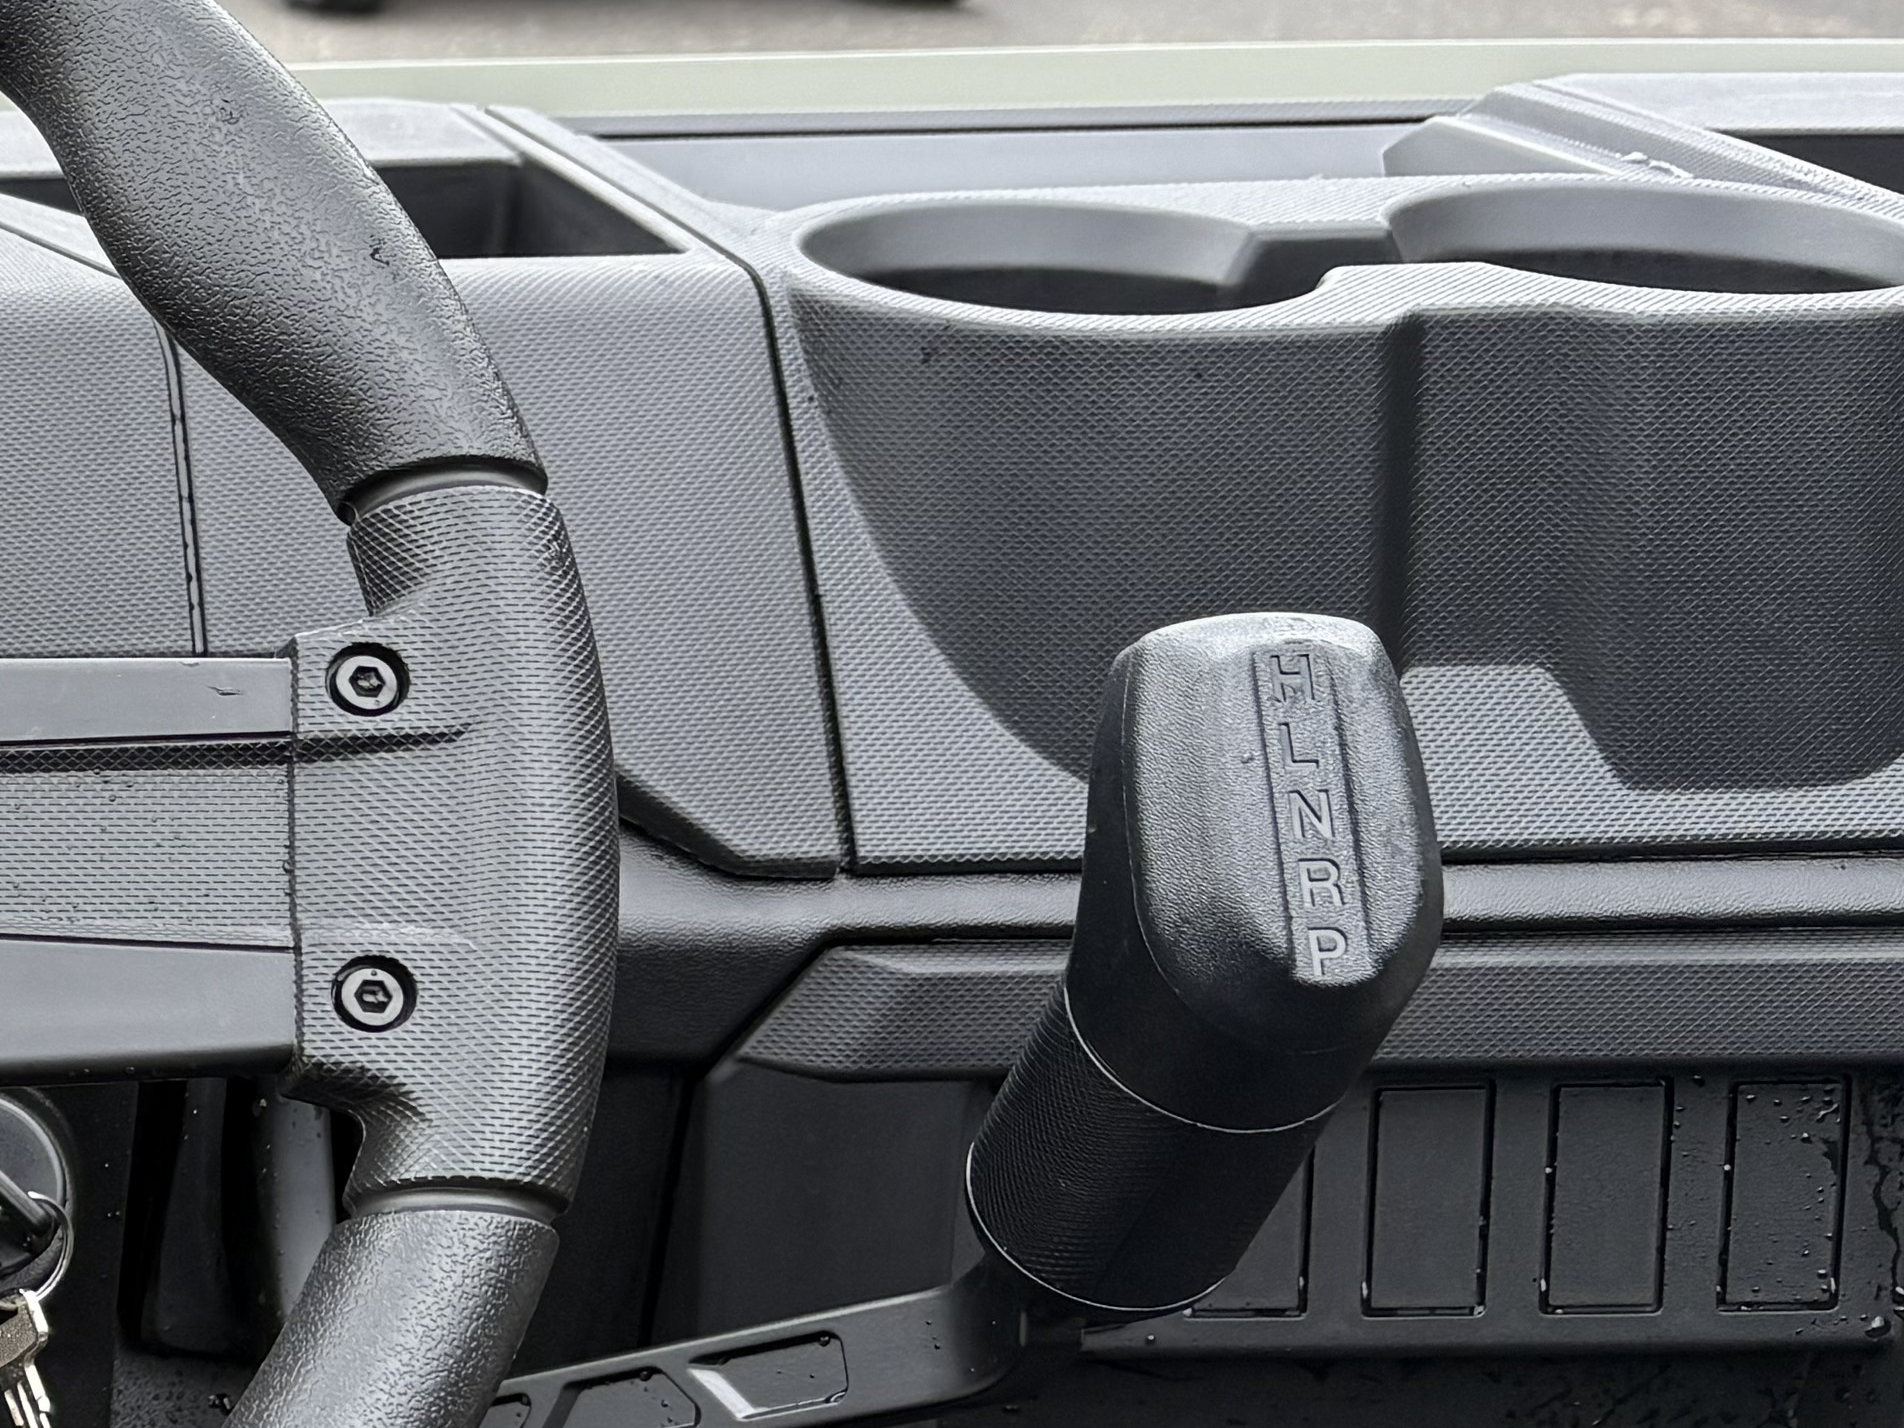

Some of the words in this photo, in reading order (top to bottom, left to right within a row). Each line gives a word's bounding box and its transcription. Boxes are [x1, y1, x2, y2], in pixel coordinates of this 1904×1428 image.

[1269, 653, 1316, 703] H
[1278, 722, 1320, 771] L
[1288, 788, 1336, 840] N
[1298, 857, 1344, 908] R
[1307, 926, 1349, 976] P
